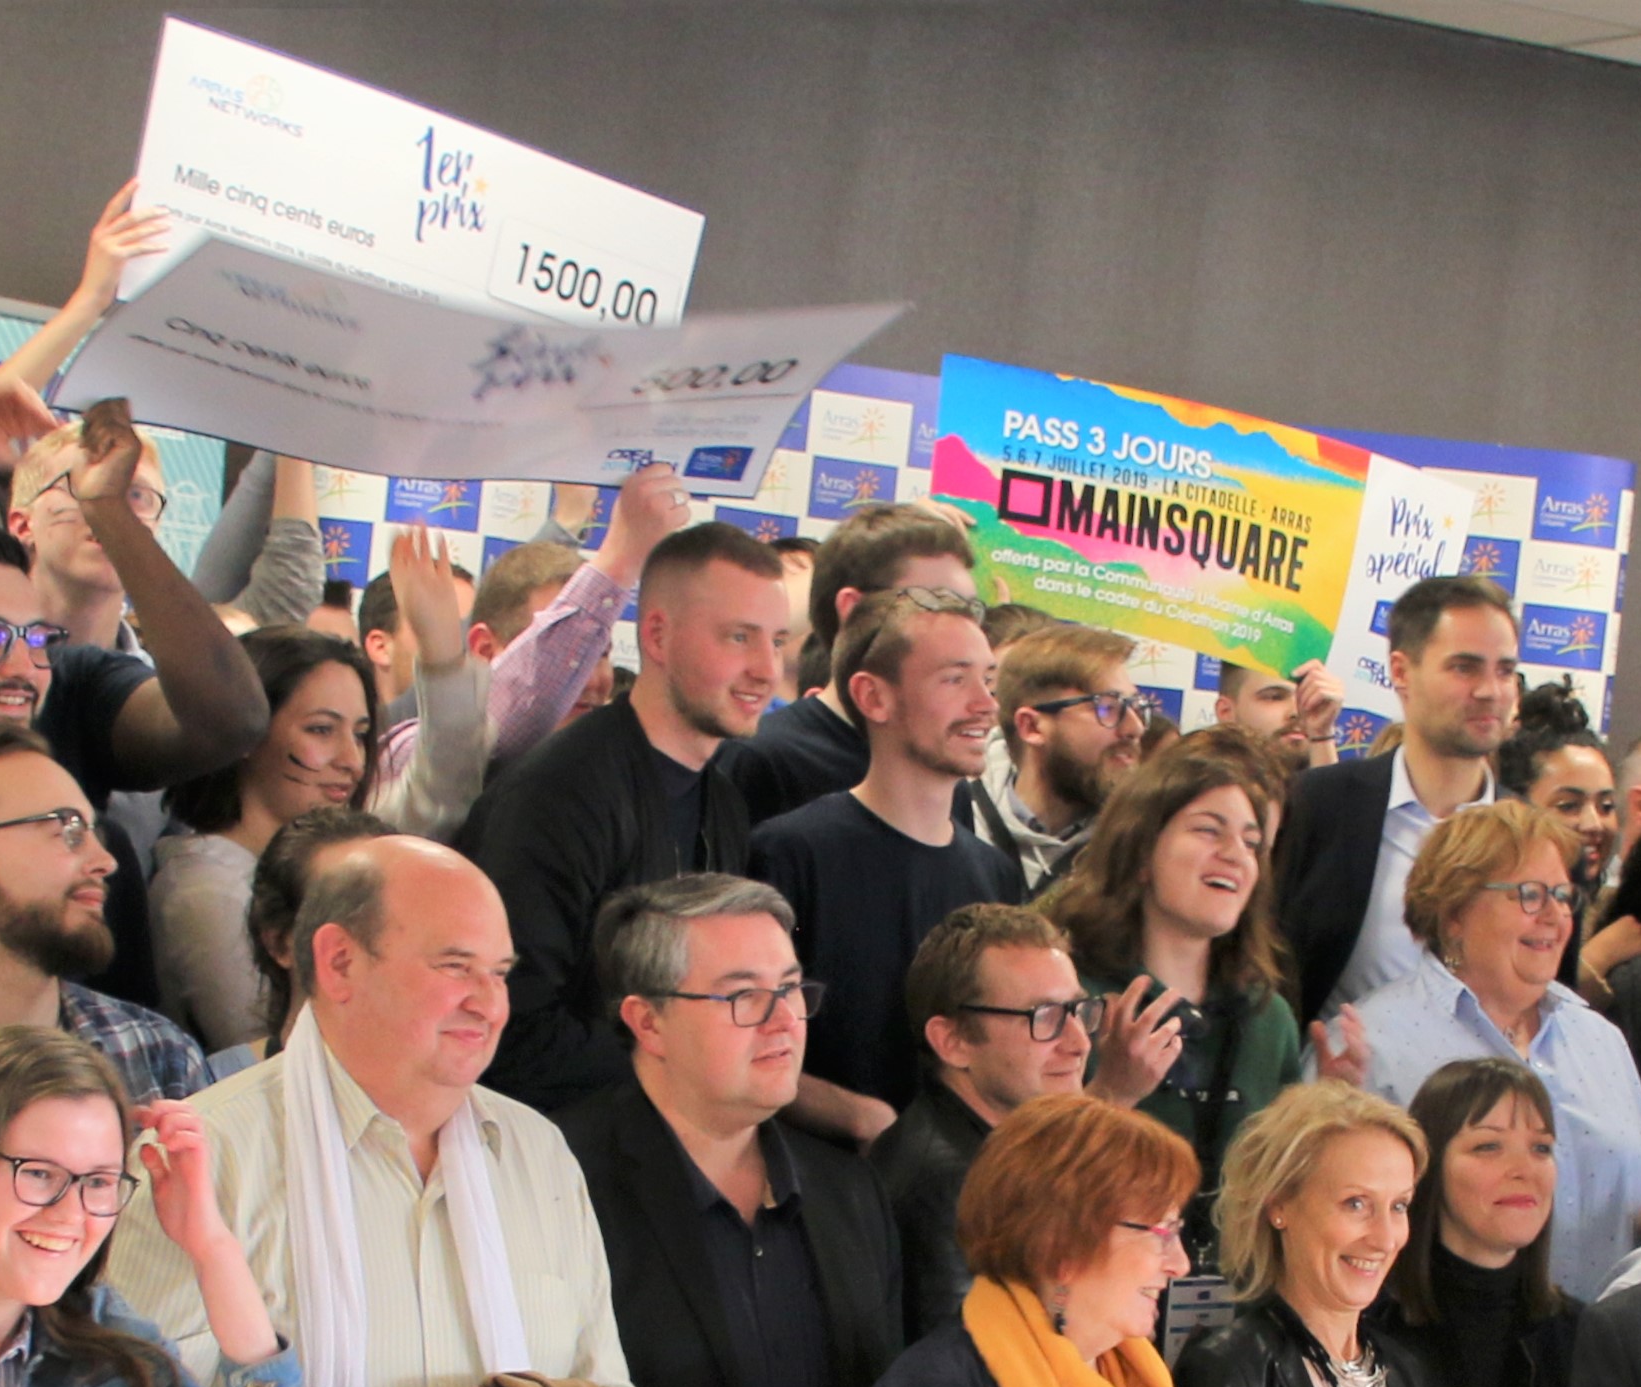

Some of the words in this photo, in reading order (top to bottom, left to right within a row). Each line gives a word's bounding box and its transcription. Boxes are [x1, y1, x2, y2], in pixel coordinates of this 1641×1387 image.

[416, 125, 474, 192] 1er
[174, 164, 221, 196] Mille
[225, 184, 269, 215] cinq
[273, 198, 324, 231] cents
[327, 219, 376, 248] euros
[414, 182, 485, 243] prix
[515, 243, 658, 327] 1500,00
[1003, 409, 1080, 451] PASS
[1086, 426, 1106, 456] 3
[1113, 432, 1214, 480] JOURS
[816, 472, 856, 490] Arras
[1047, 455, 1107, 480] JUILLET
[1112, 467, 1149, 490] 2019
[1162, 477, 1181, 497] LA
[1185, 481, 1258, 519] CITADELLE
[1270, 505, 1313, 534] ARRAS
[1540, 495, 1586, 516] Arras
[1056, 479, 1309, 593] MAINSQUARE
[1389, 496, 1435, 541] Prix
[991, 548, 1041, 572] offerts
[1043, 557, 1072, 577] par
[1073, 560, 1092, 579] la
[1365, 541, 1447, 584] spécial
[1034, 575, 1077, 597] dans
[1078, 580, 1092, 599] le
[1094, 585, 1140, 611] cadre
[1143, 596, 1164, 616] du
[1231, 620, 1263, 643] 2019
[1526, 617, 1572, 638] Arras
